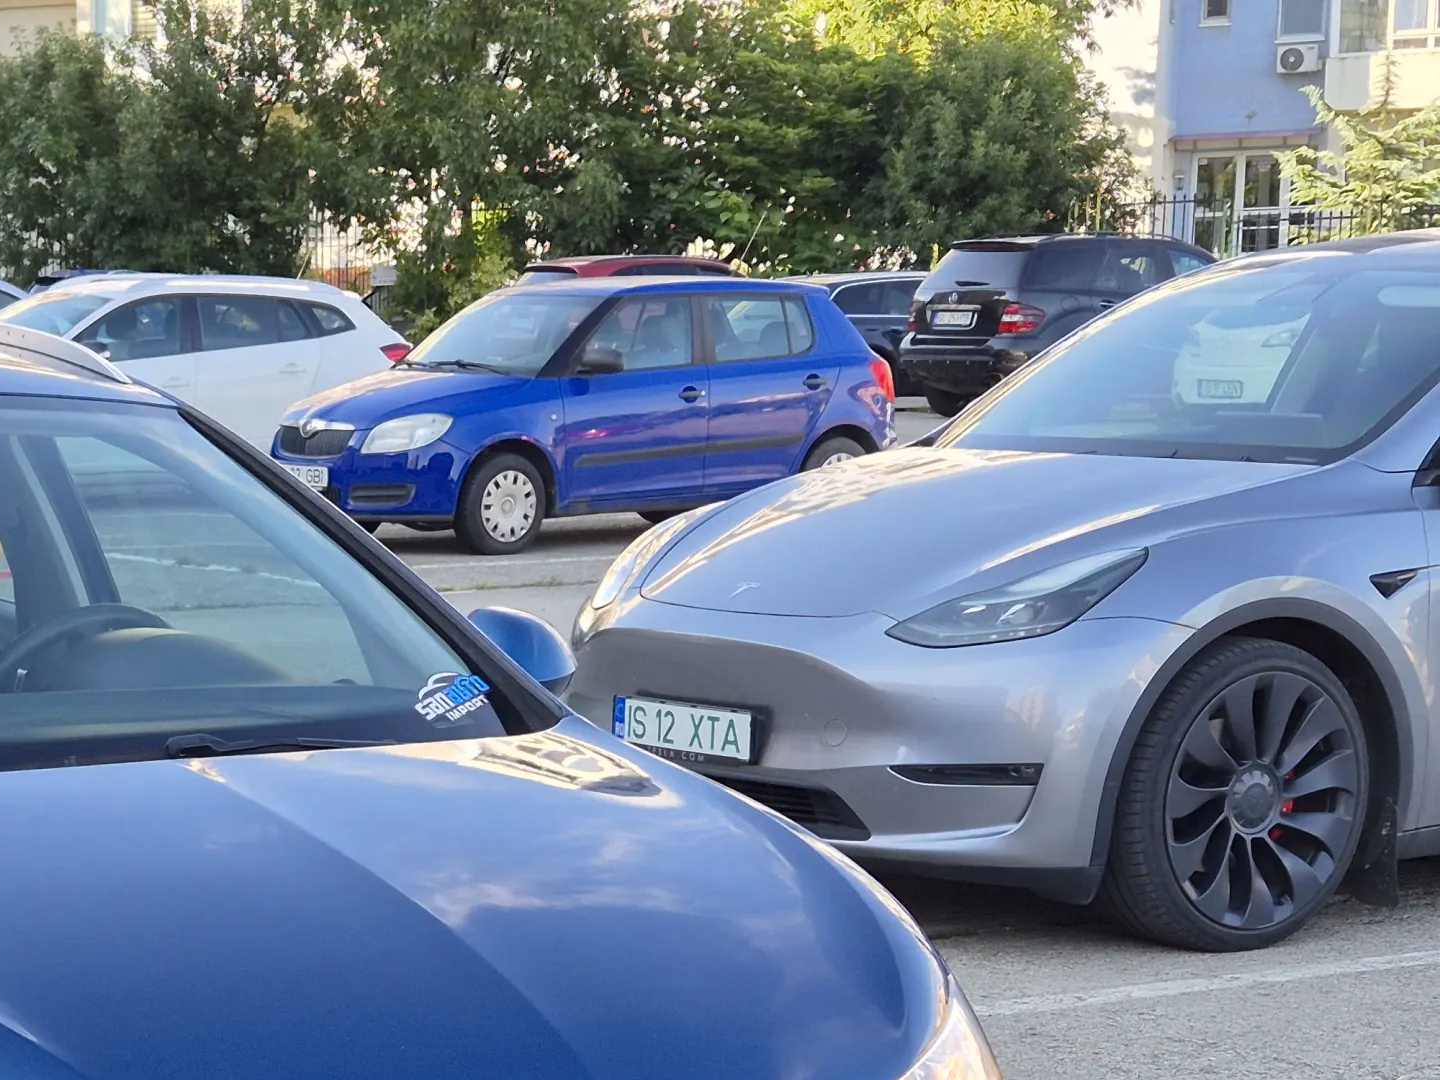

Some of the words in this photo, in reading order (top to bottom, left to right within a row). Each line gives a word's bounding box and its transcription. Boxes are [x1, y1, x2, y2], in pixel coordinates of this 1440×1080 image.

[445, 694, 489, 721] IMPORT
[627, 704, 647, 739] IS
[656, 708, 676, 745] 12
[689, 713, 741, 753] XTA
